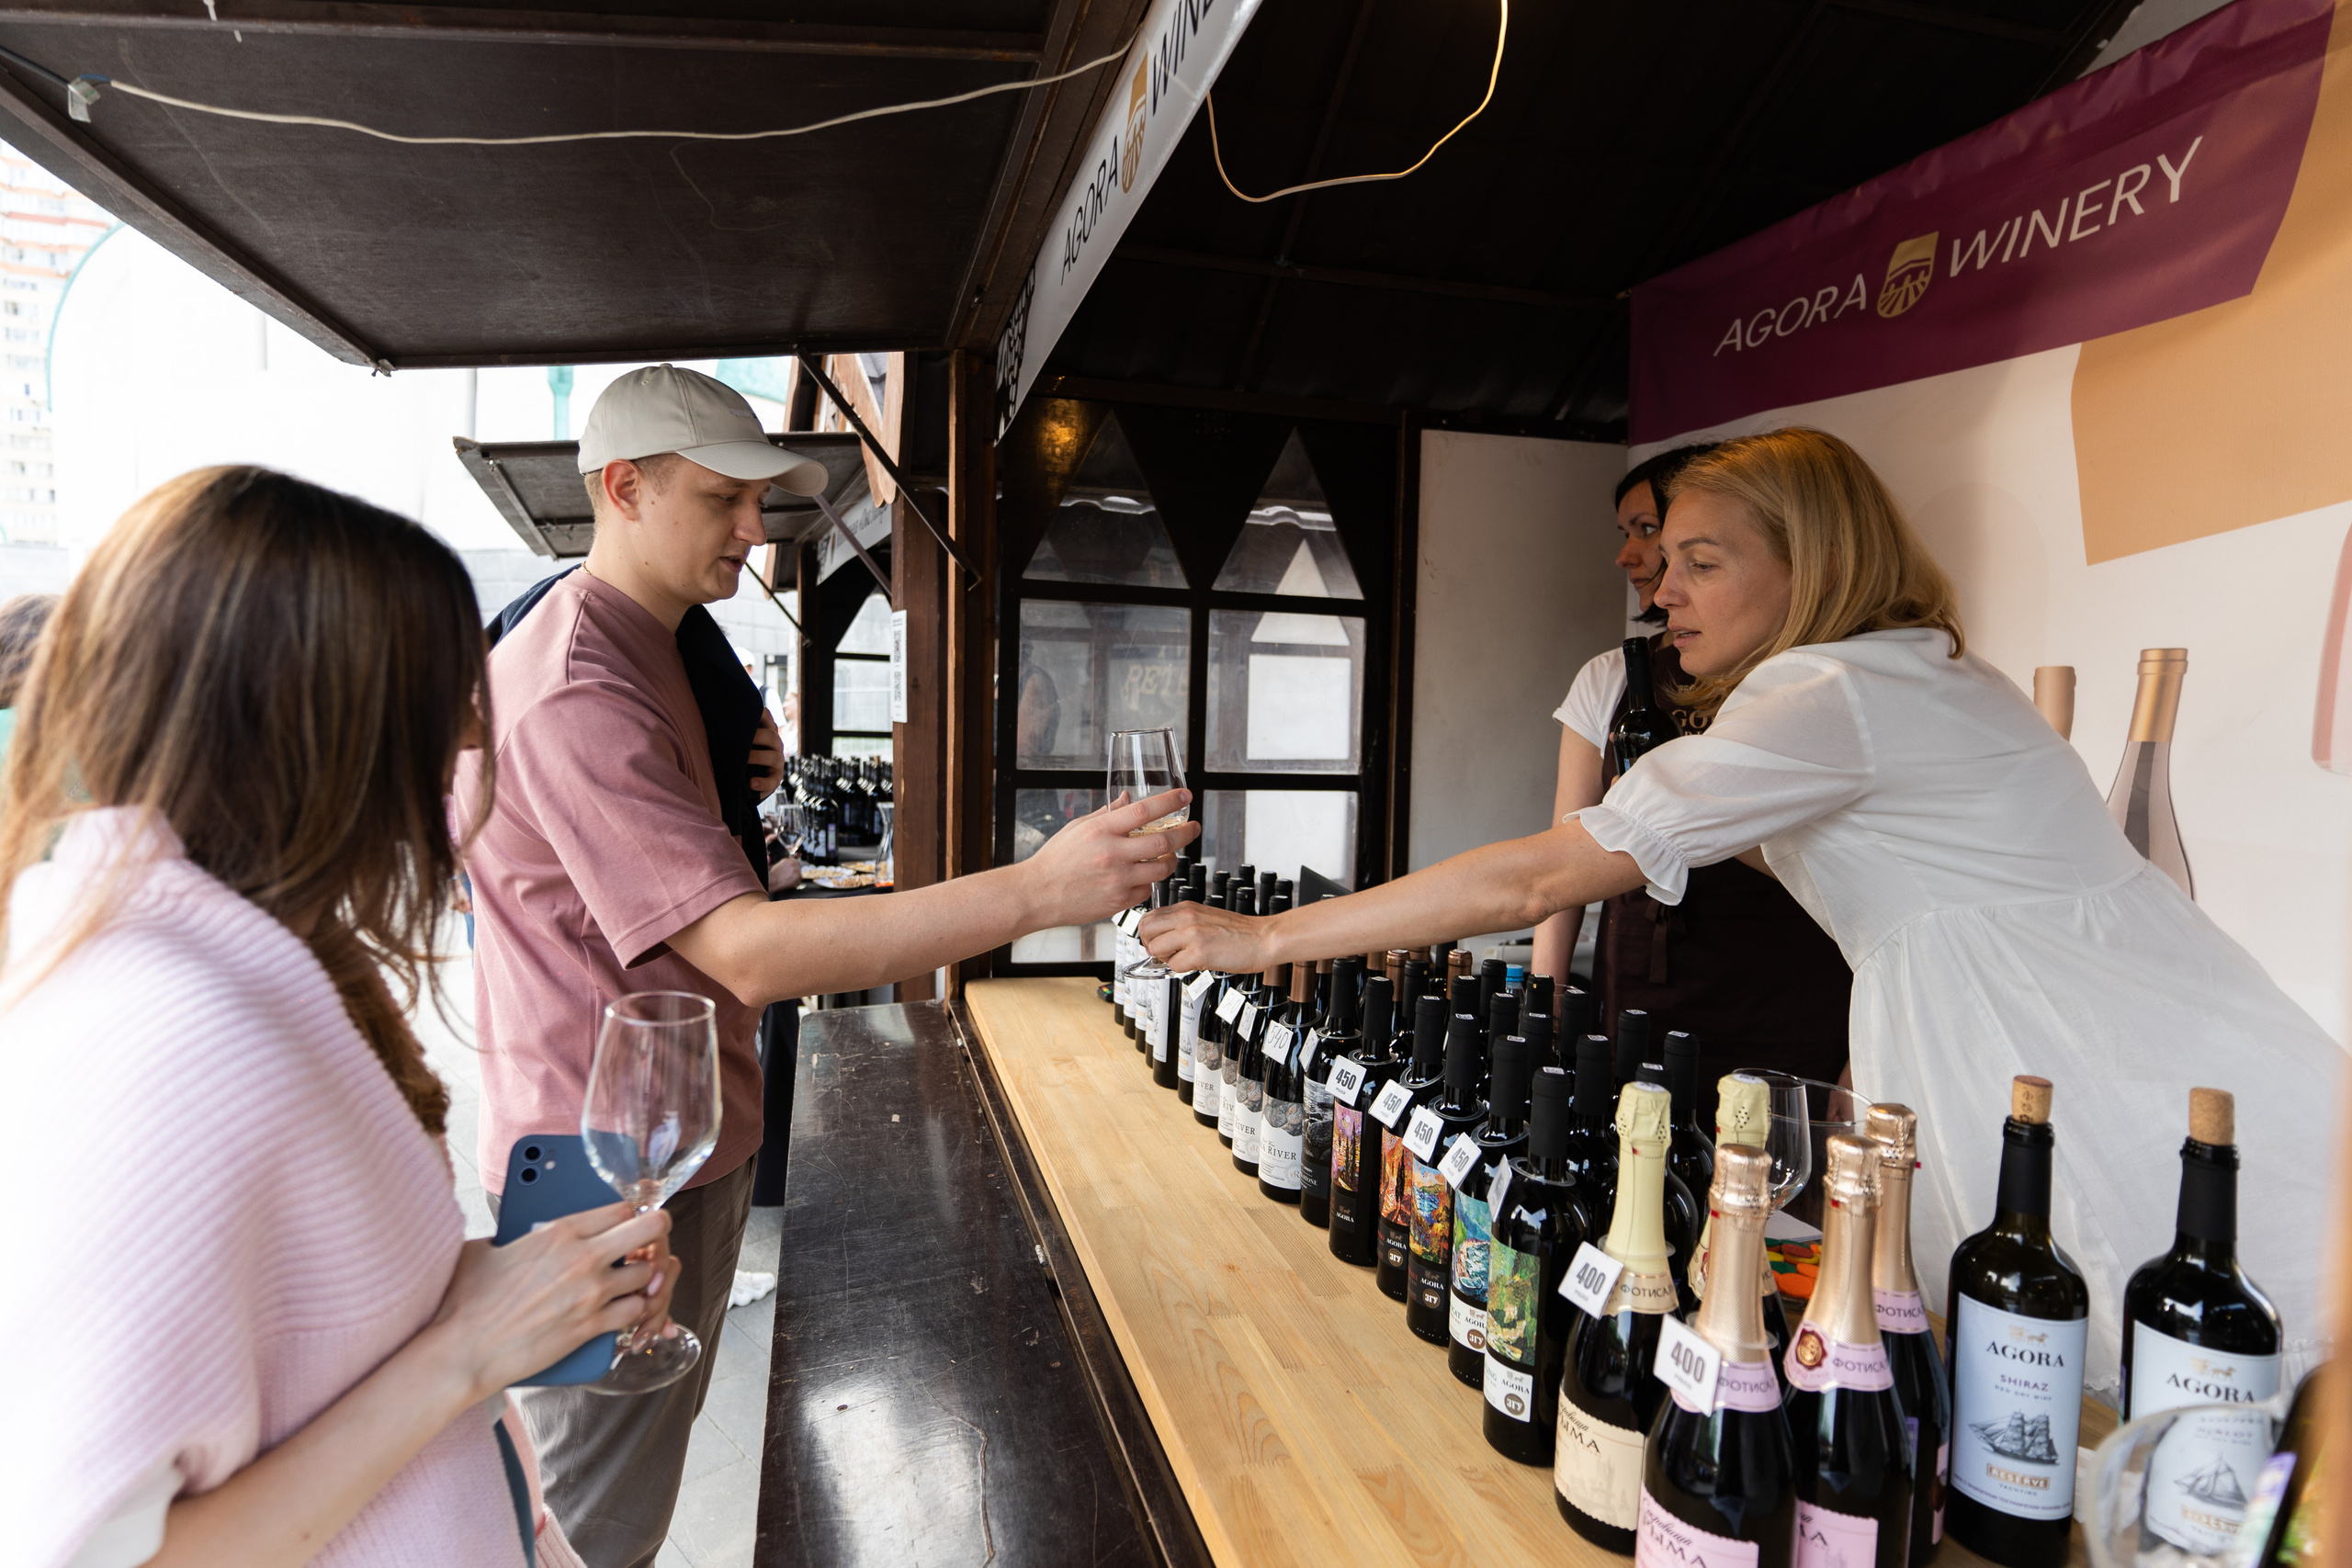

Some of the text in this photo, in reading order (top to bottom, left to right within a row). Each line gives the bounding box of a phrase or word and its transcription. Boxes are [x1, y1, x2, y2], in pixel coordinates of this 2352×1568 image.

[1061, 0, 1213, 286] AGORA WIN
[1713, 135, 2204, 357] AGORA WINERY
[1268, 1024, 1289, 1049] 540
[1336, 1068, 1357, 1090] 450
[1383, 1092, 1402, 1113] 450
[1414, 1120, 1433, 1145] 450
[1267, 1145, 1297, 1160] RIVER
[1451, 1147, 1470, 1173] 450
[1385, 1237, 1408, 1250] AGORA
[1419, 1277, 1444, 1290] AGORA
[1576, 1262, 1606, 1295] 400
[1424, 1293, 1439, 1304] ЗГУ
[1464, 1316, 1486, 1329] AGOR
[1468, 1332, 1484, 1345] ЗГУ
[1670, 1340, 1706, 1384] 400
[1985, 1340, 2065, 1368] AGORA
[1501, 1379, 1531, 1394] AGORA
[2000, 1374, 2050, 1392] SHIRAZ
[2165, 1372, 2256, 1404] AGORA
[1506, 1397, 1523, 1412] ЗГУ
[1989, 1468, 2046, 1489] RESERVE
